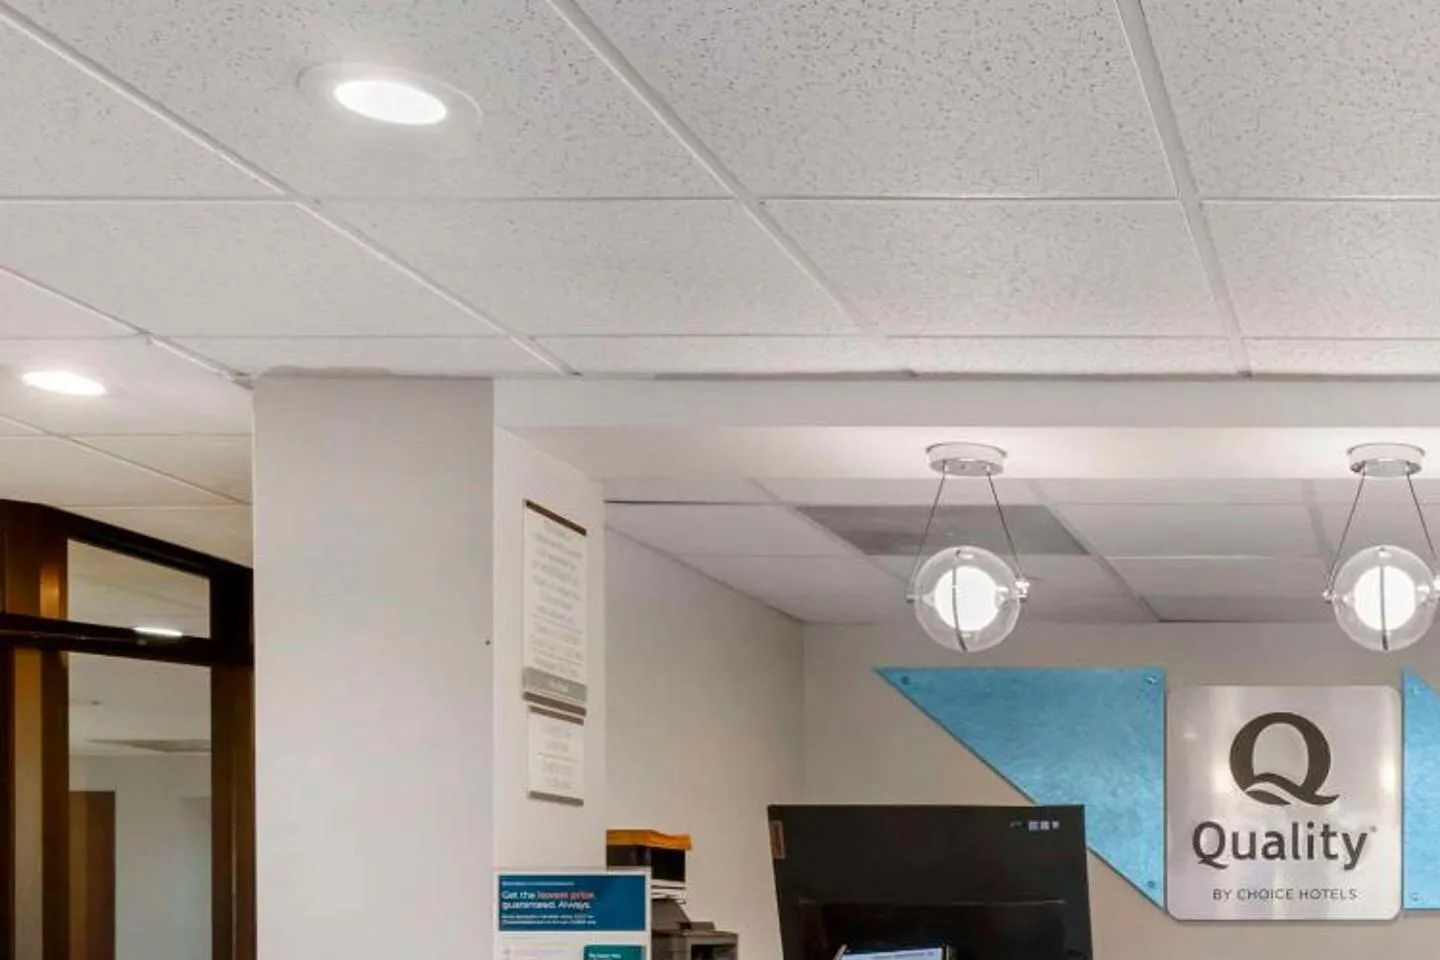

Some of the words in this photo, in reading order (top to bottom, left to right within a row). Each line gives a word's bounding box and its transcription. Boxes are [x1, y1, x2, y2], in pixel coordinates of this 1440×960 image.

[1229, 711, 1339, 806] Q
[1192, 820, 1368, 871] Quality
[502, 891, 517, 899] Get
[519, 890, 536, 899] the
[1213, 888, 1232, 900] BY
[1236, 888, 1294, 900] CHOICE
[1298, 888, 1359, 900] HOTELS
